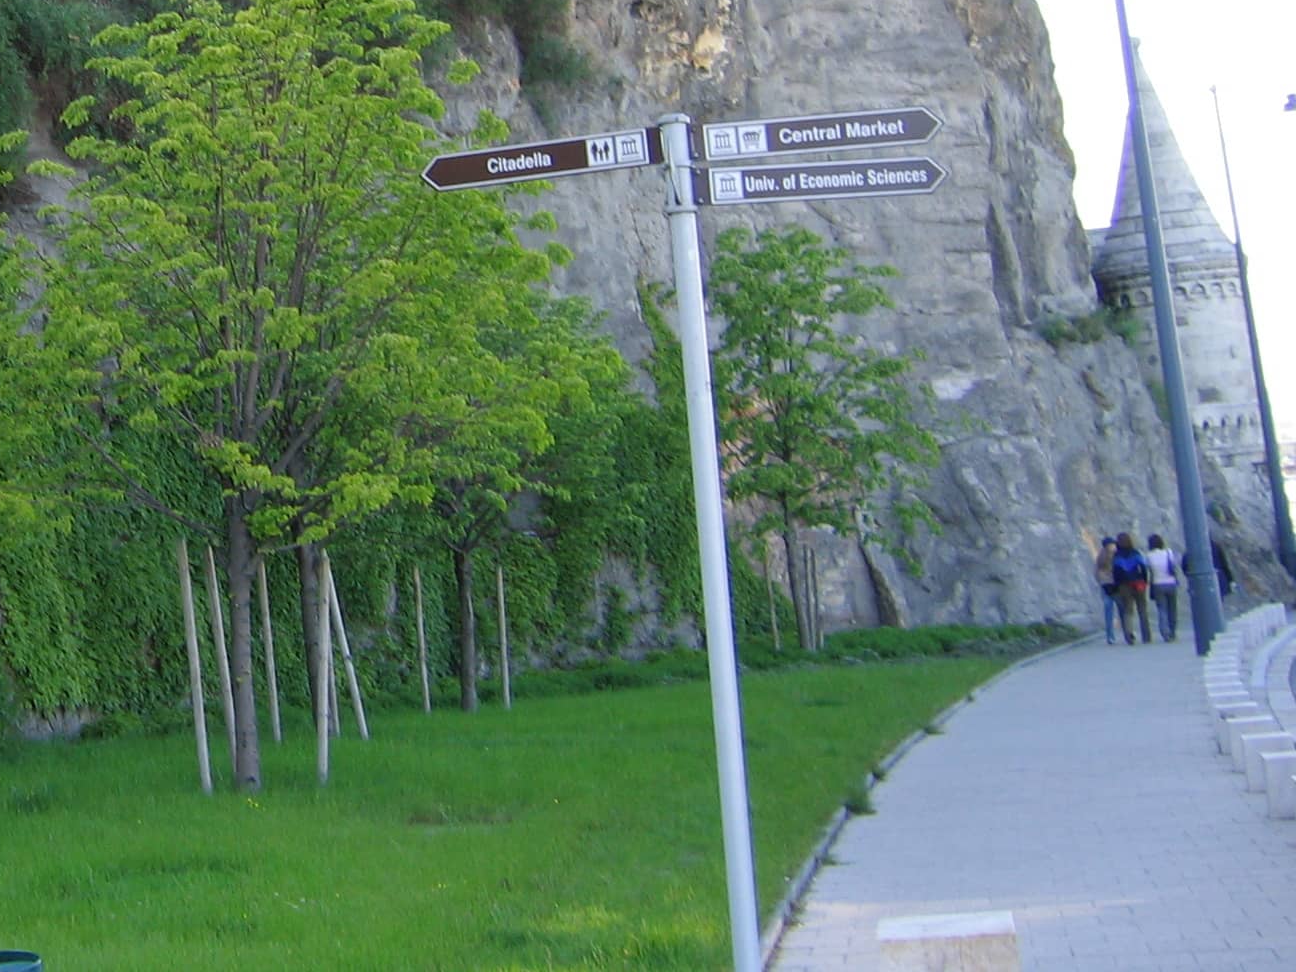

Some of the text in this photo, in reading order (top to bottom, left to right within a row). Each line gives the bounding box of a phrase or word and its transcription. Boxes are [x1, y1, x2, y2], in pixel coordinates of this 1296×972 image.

[778, 119, 905, 144] Central Market
[487, 152, 552, 174] Citadella
[744, 168, 928, 192] Univ. of Economic Sciences
